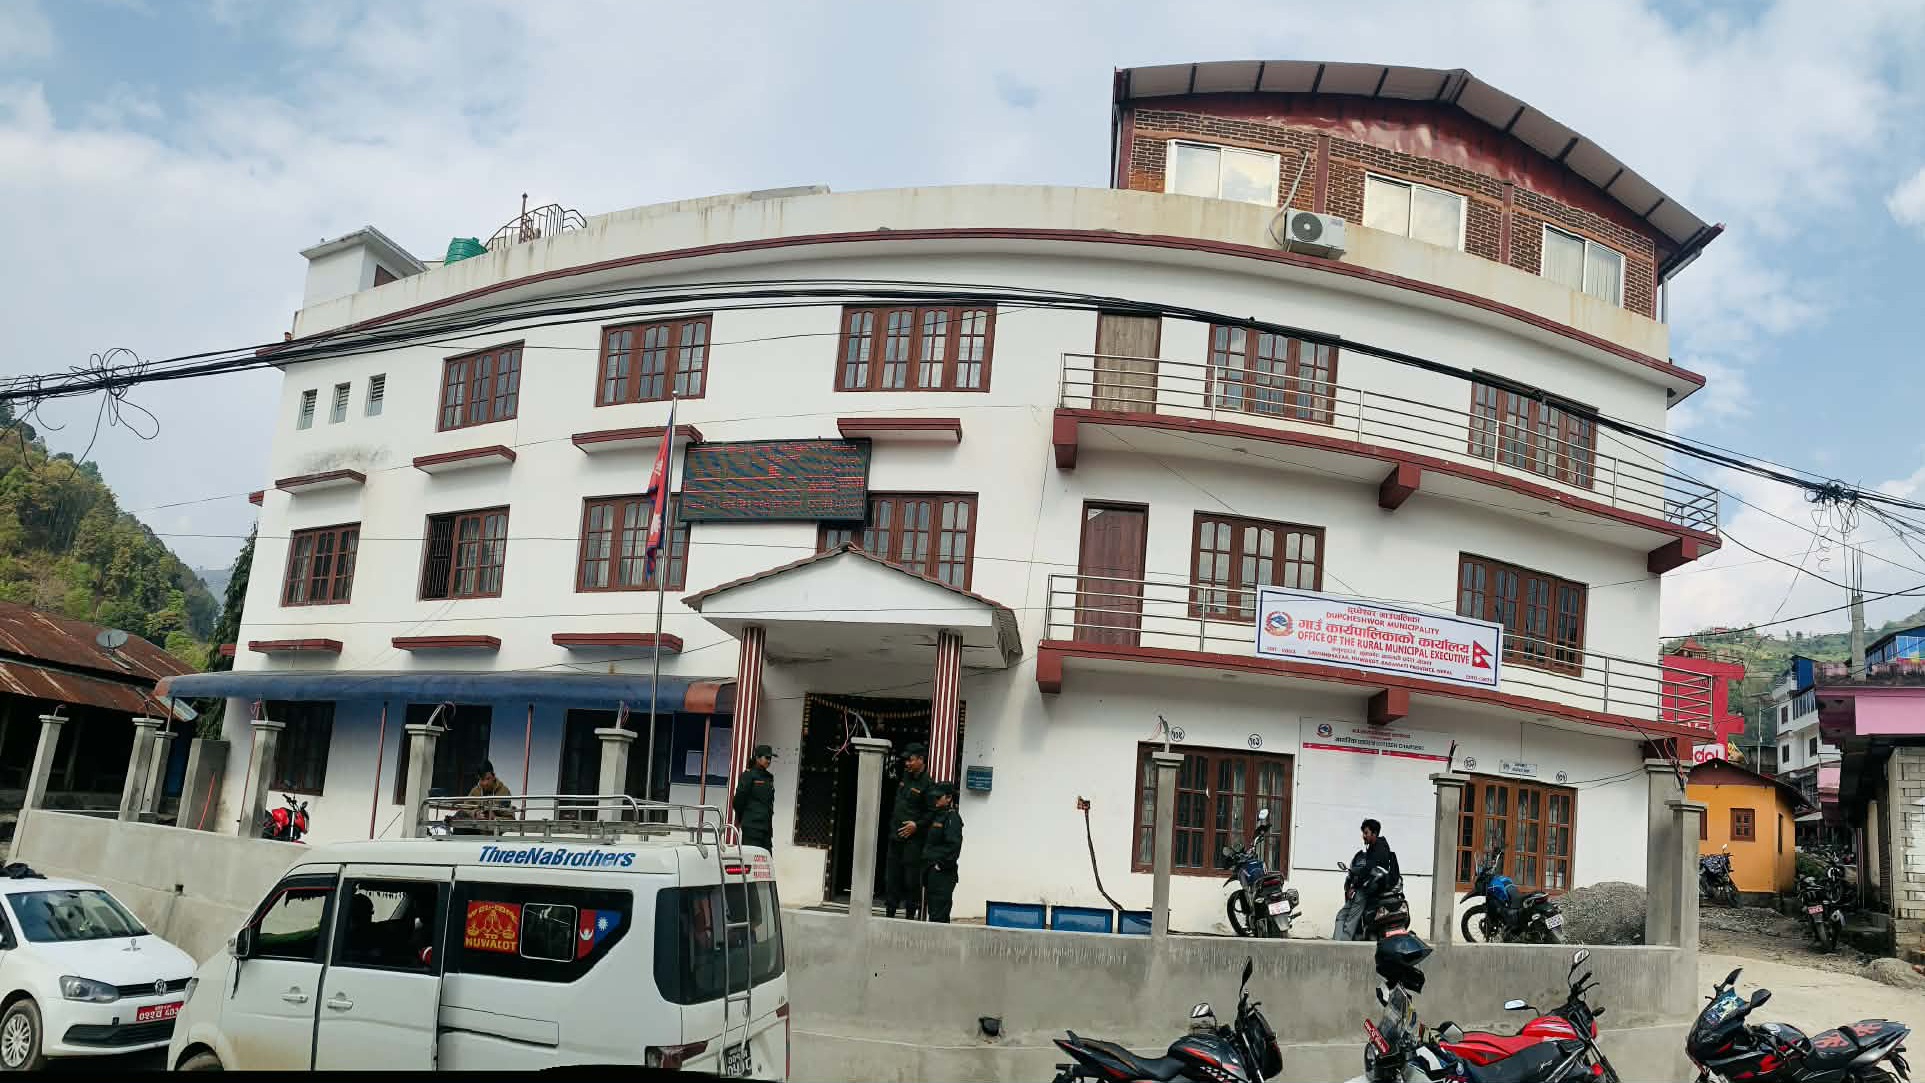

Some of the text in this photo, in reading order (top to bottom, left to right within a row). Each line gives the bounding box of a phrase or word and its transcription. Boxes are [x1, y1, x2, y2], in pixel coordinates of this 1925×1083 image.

[1387, 621, 1440, 635] MUNICIPALITY
[1297, 631, 1326, 642] OFFICE
[1326, 635, 1337, 644] OF
[1340, 636, 1355, 646] THE
[1357, 639, 1383, 651] RURAL
[1385, 643, 1428, 659] MUNICIPAL
[1430, 650, 1470, 665] EXECUTIVE
[1418, 637, 1470, 654] कार्यालय
